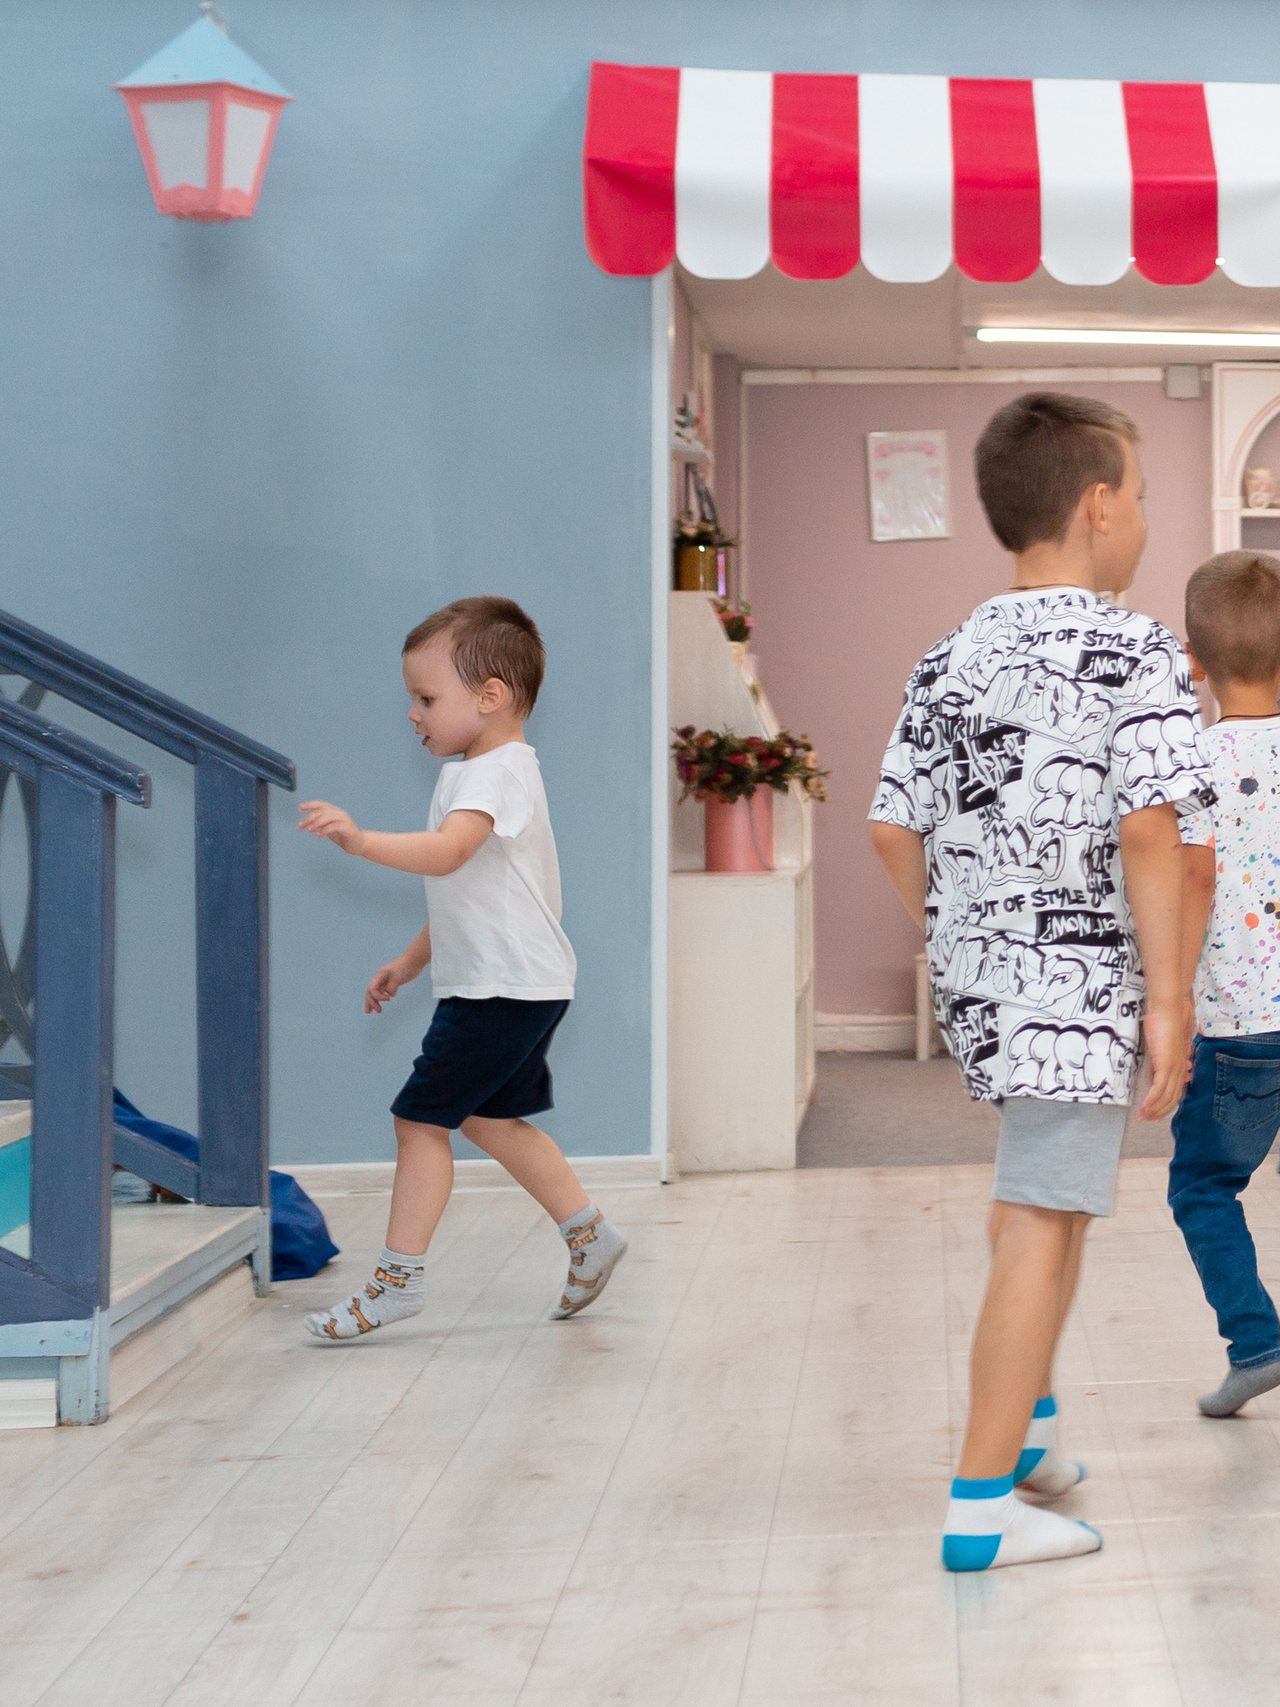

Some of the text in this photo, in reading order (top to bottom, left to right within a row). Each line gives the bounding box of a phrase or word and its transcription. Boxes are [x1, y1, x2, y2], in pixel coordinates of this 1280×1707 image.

[1055, 628, 1078, 645] OF
[1081, 628, 1138, 651] STYLE
[1003, 893, 1026, 913] OF
[1030, 886, 1088, 908] STYLE
